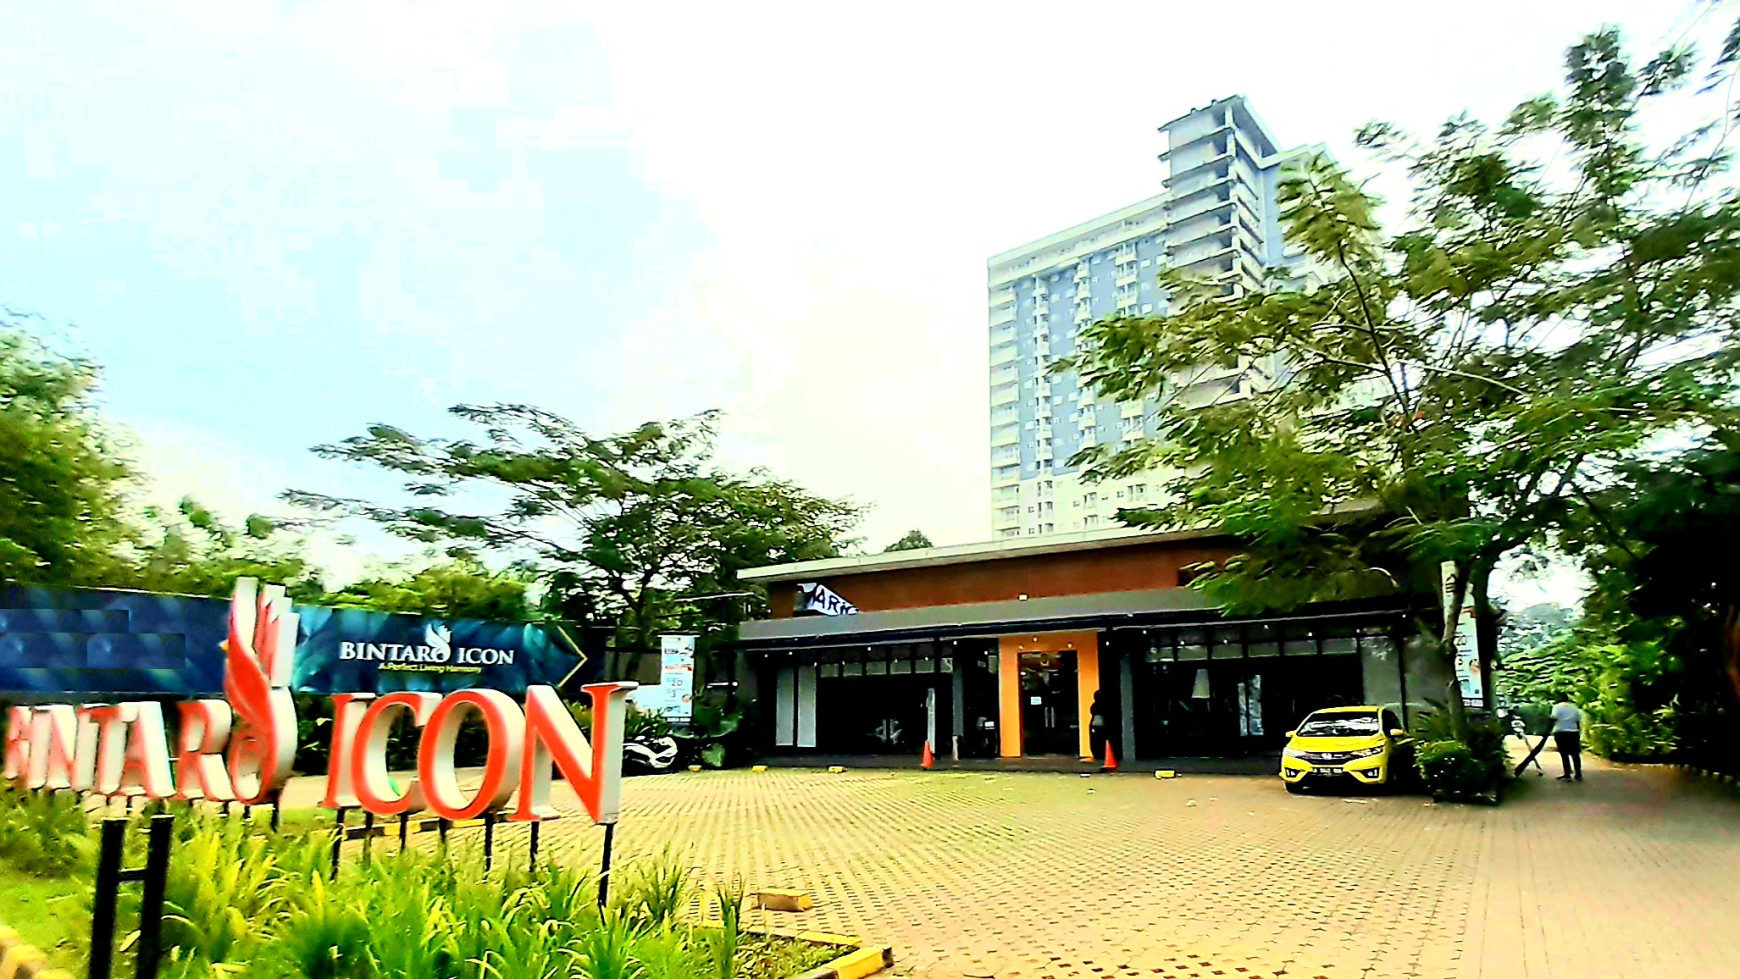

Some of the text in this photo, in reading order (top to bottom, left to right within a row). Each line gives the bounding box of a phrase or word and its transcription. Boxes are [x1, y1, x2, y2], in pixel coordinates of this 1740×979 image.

[339, 641, 514, 665] BINTARO ICON
[324, 681, 639, 824] ICON
